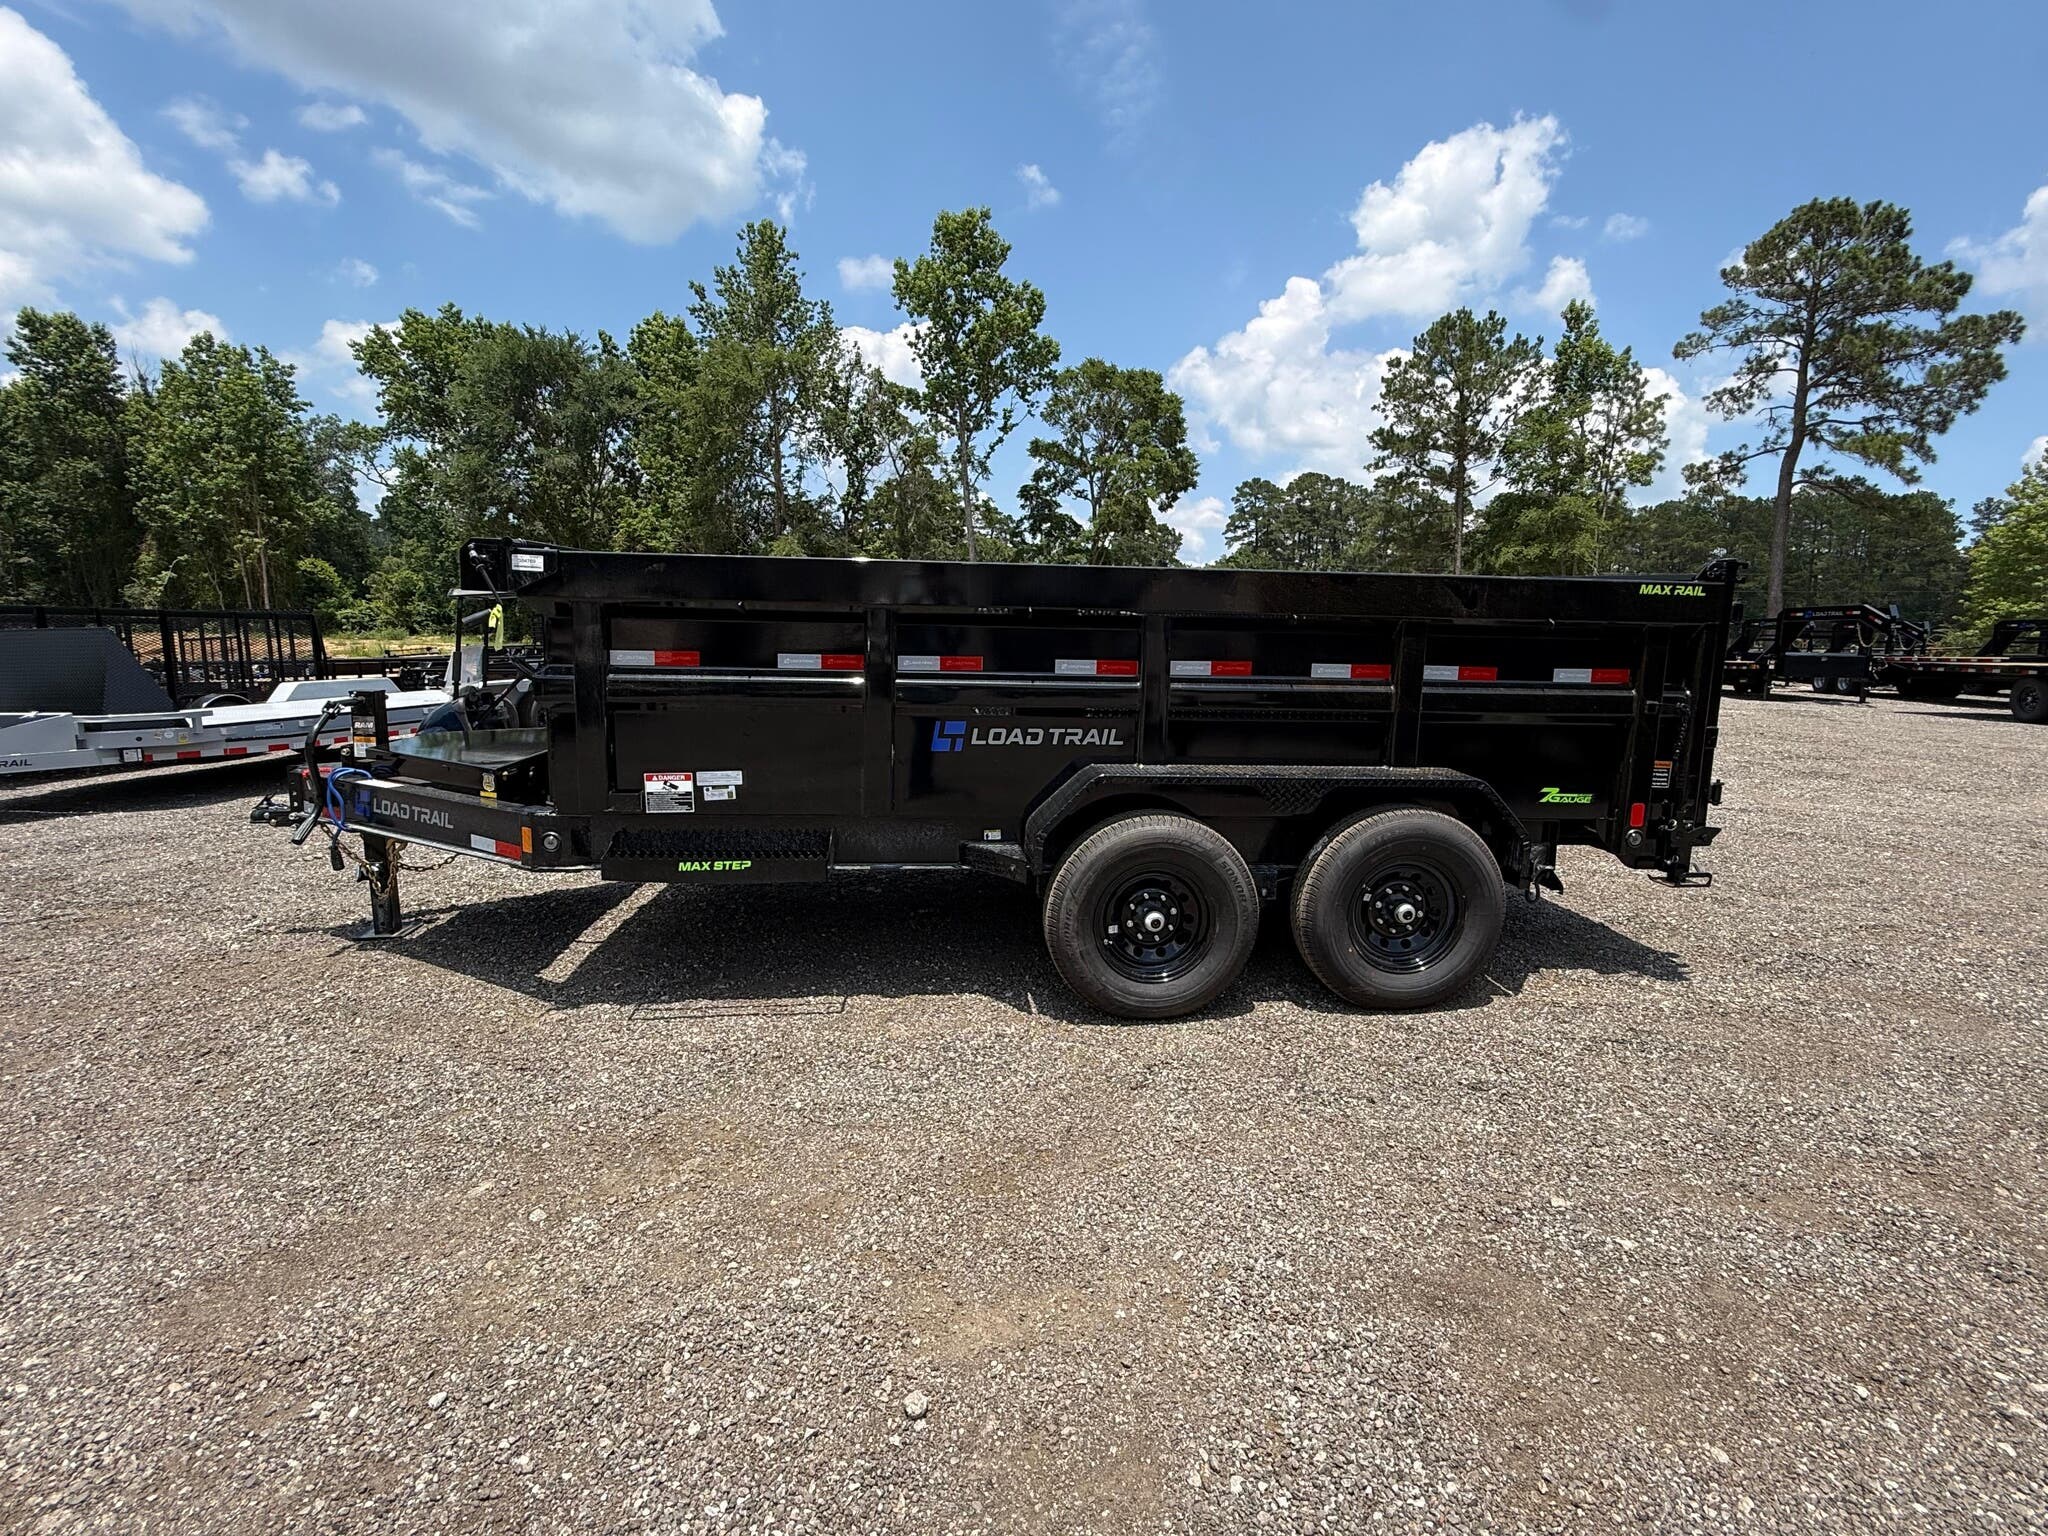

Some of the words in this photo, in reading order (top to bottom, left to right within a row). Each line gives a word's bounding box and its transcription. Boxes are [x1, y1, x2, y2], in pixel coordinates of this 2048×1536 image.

[1639, 584, 1673, 595] MAX
[1674, 585, 1706, 597] RAIL
[354, 721, 374, 729] RAM
[971, 728, 1045, 746] LOAD
[1049, 728, 1124, 746] TRAIL
[1549, 795, 1593, 804] GAUGE
[372, 798, 410, 820] LOAD
[412, 806, 455, 829] TRAIL
[678, 861, 712, 872] MAX
[713, 860, 752, 871] STEP
